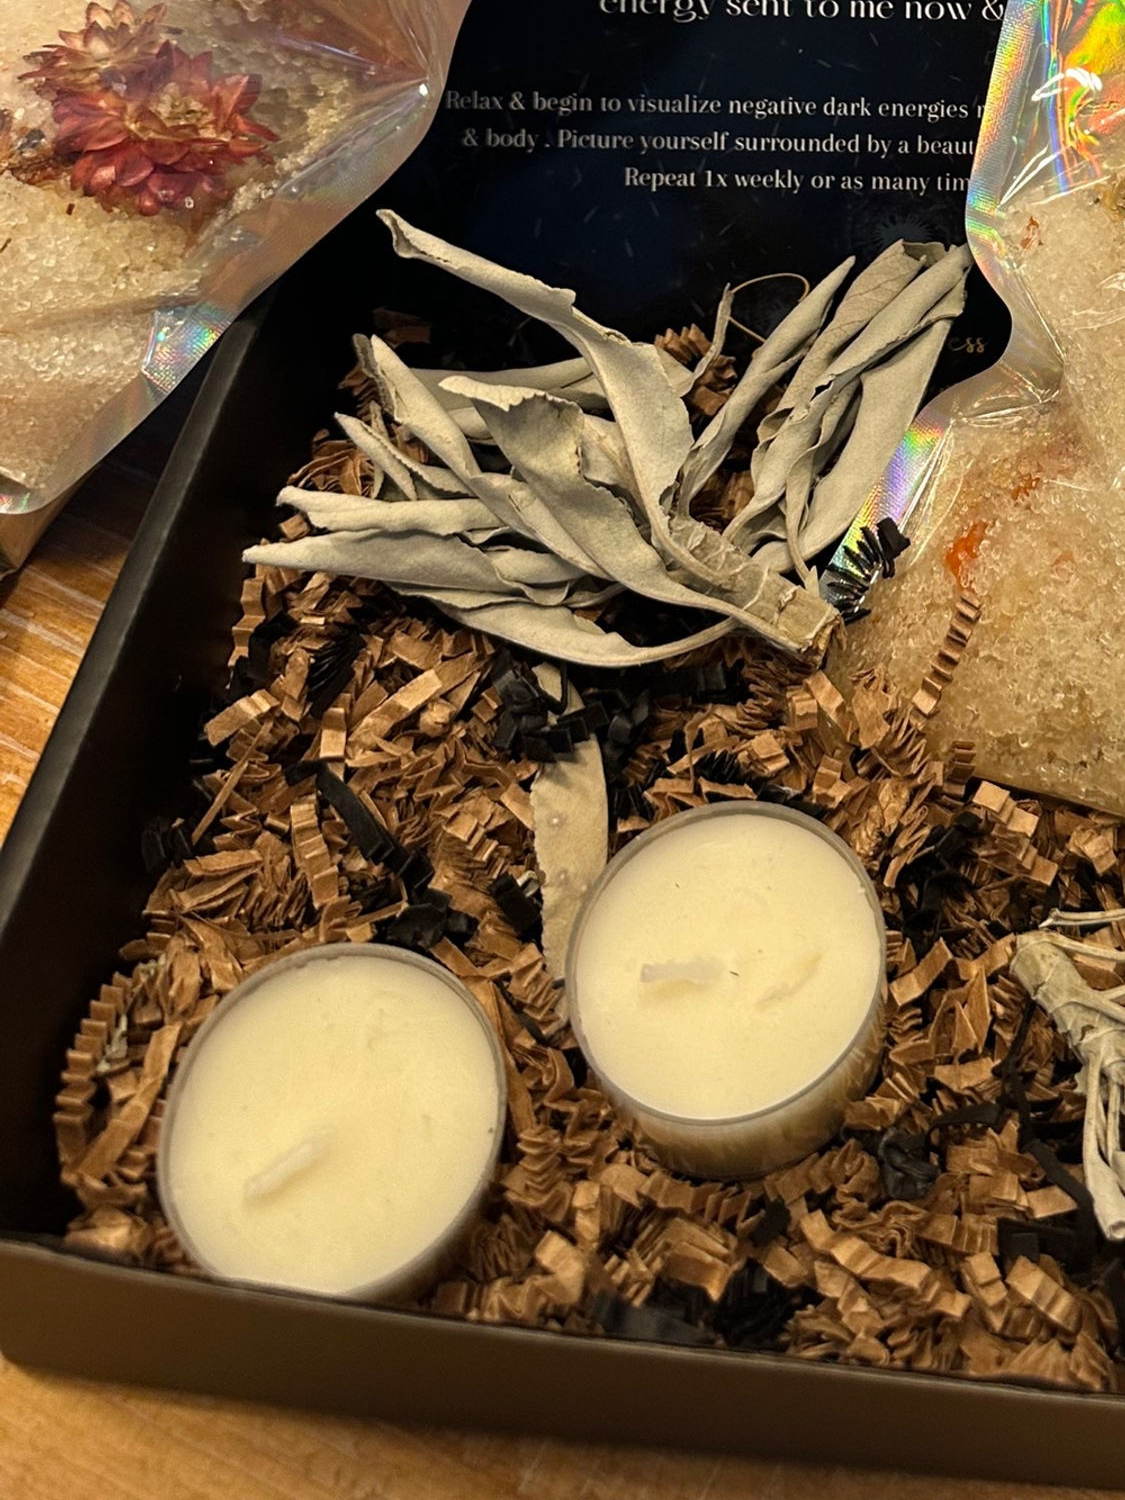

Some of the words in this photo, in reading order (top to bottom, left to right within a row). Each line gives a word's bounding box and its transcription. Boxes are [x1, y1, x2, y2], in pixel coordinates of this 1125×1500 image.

[851, 1, 893, 20] me
[905, 1, 972, 21] now
[446, 90, 503, 110] Relax
[534, 91, 592, 116] begin
[601, 96, 621, 112] to
[627, 94, 721, 115] visualize
[729, 97, 816, 119] negative
[824, 97, 871, 118] dark
[879, 100, 968, 122] energies
[486, 128, 537, 153] body
[558, 130, 633, 150] Picture
[640, 132, 729, 155] yourself
[735, 133, 859, 155] surrounded
[867, 134, 891, 158] by
[898, 140, 909, 155] a
[917, 135, 975, 157] beaut
[624, 167, 696, 191] Repeat
[704, 169, 728, 188] 1x
[735, 169, 803, 194] weekly
[811, 175, 835, 190] or
[841, 175, 863, 192] as
[871, 175, 929, 196] many
